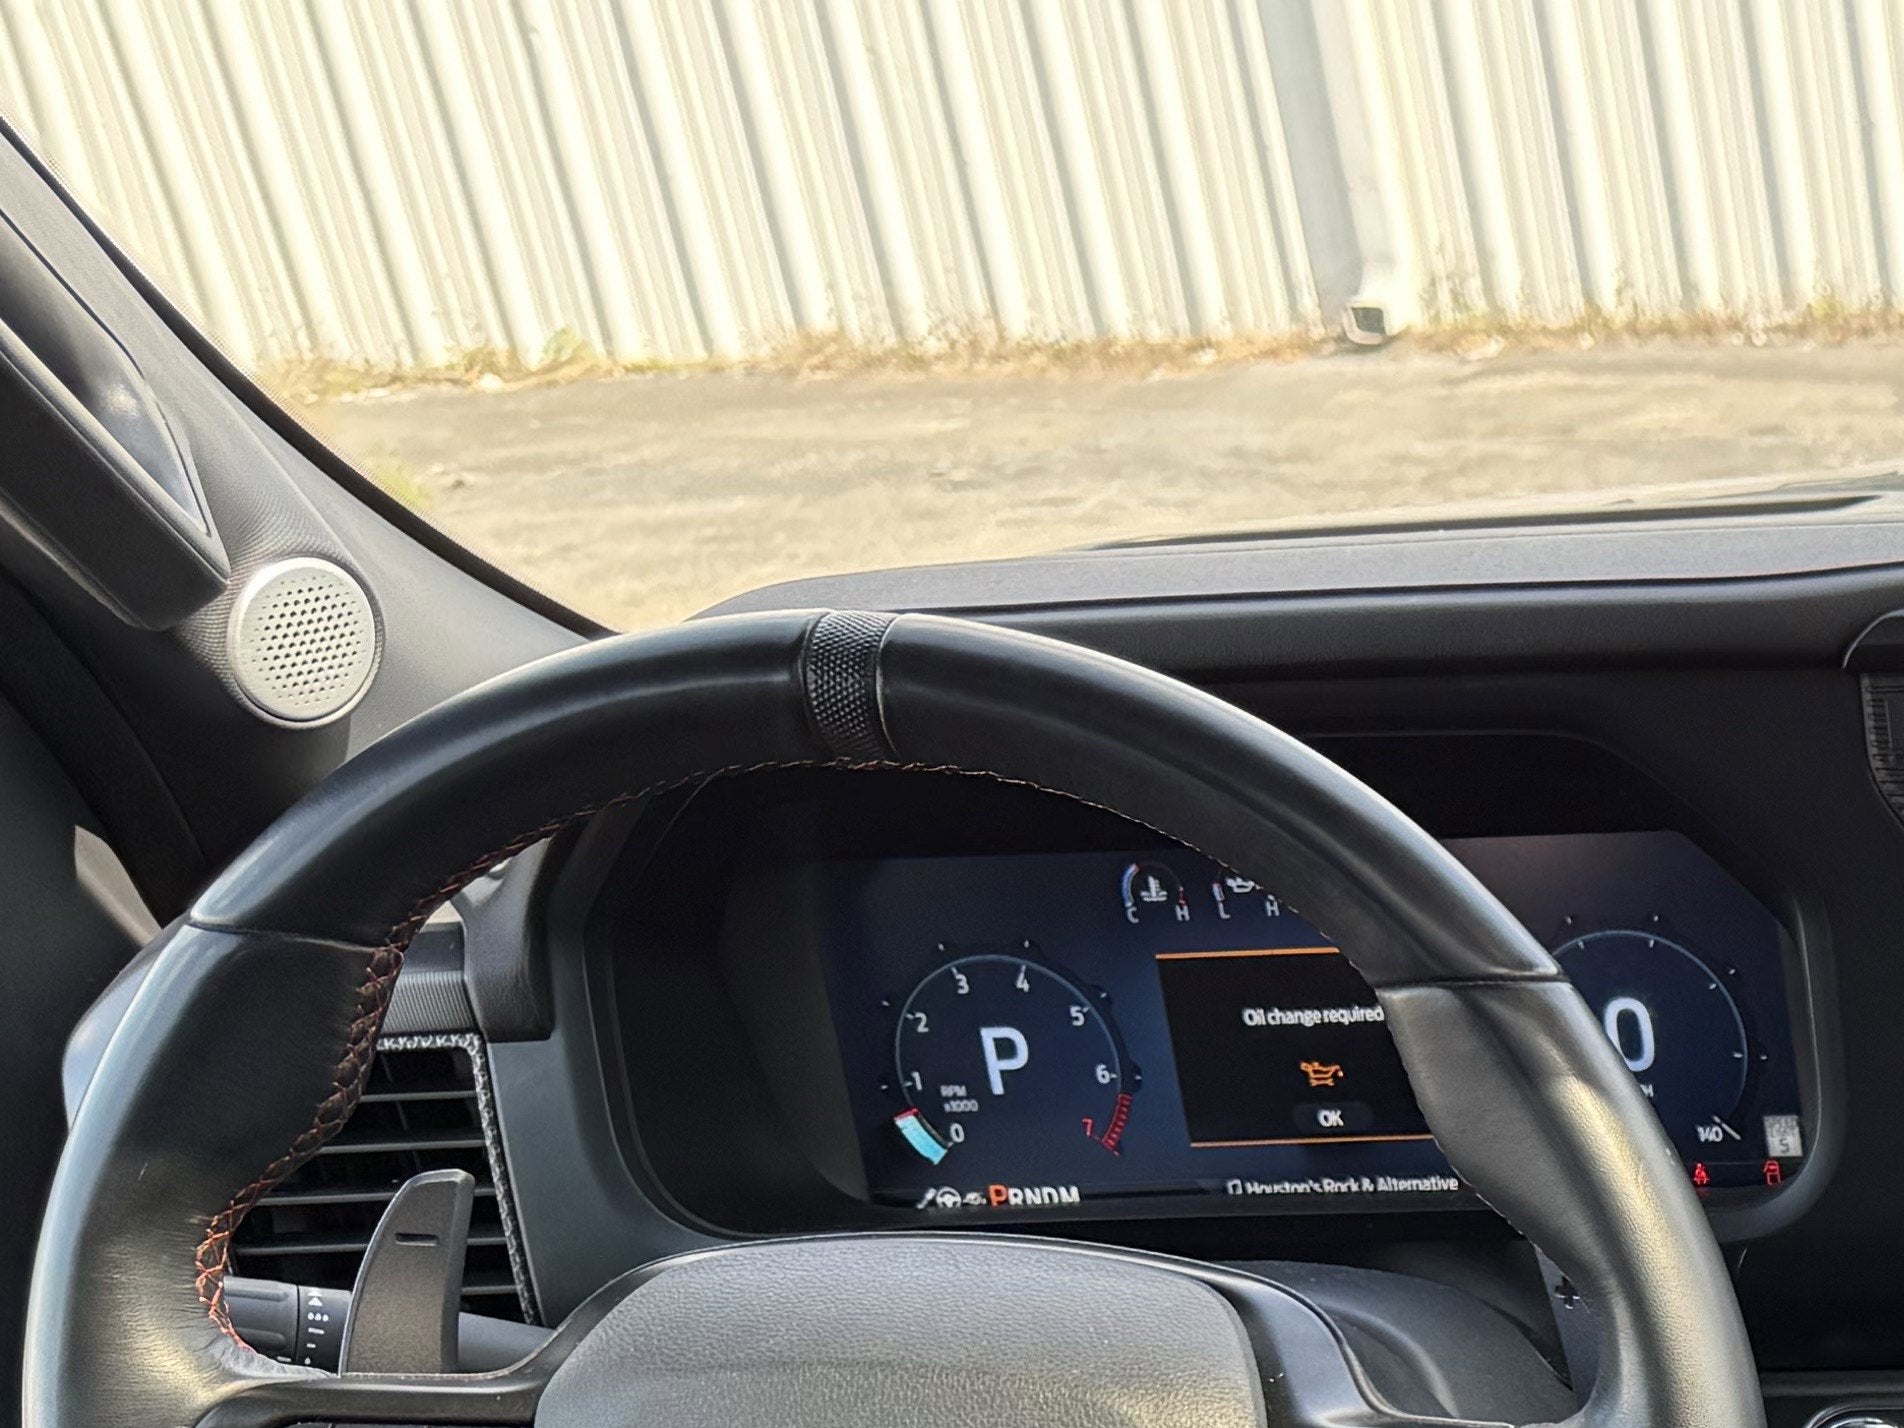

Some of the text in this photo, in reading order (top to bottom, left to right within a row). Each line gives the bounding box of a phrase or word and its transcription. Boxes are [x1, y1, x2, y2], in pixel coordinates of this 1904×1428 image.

[1126, 907, 1139, 923] C
[1176, 905, 1190, 921] H
[1219, 904, 1231, 919] L
[956, 973, 969, 994] 3
[1016, 974, 1030, 992] 4
[914, 1012, 929, 1033] 2
[1070, 1006, 1084, 1026] 5
[1243, 1004, 1385, 1028] Oil change required
[1605, 997, 1655, 1071] 0
[980, 1026, 1029, 1095] P
[911, 1071, 922, 1091] 1
[1095, 1063, 1111, 1084] 6
[1317, 1109, 1344, 1127] OK
[950, 1123, 965, 1143] 0
[1376, 1175, 1459, 1193] Alternative
